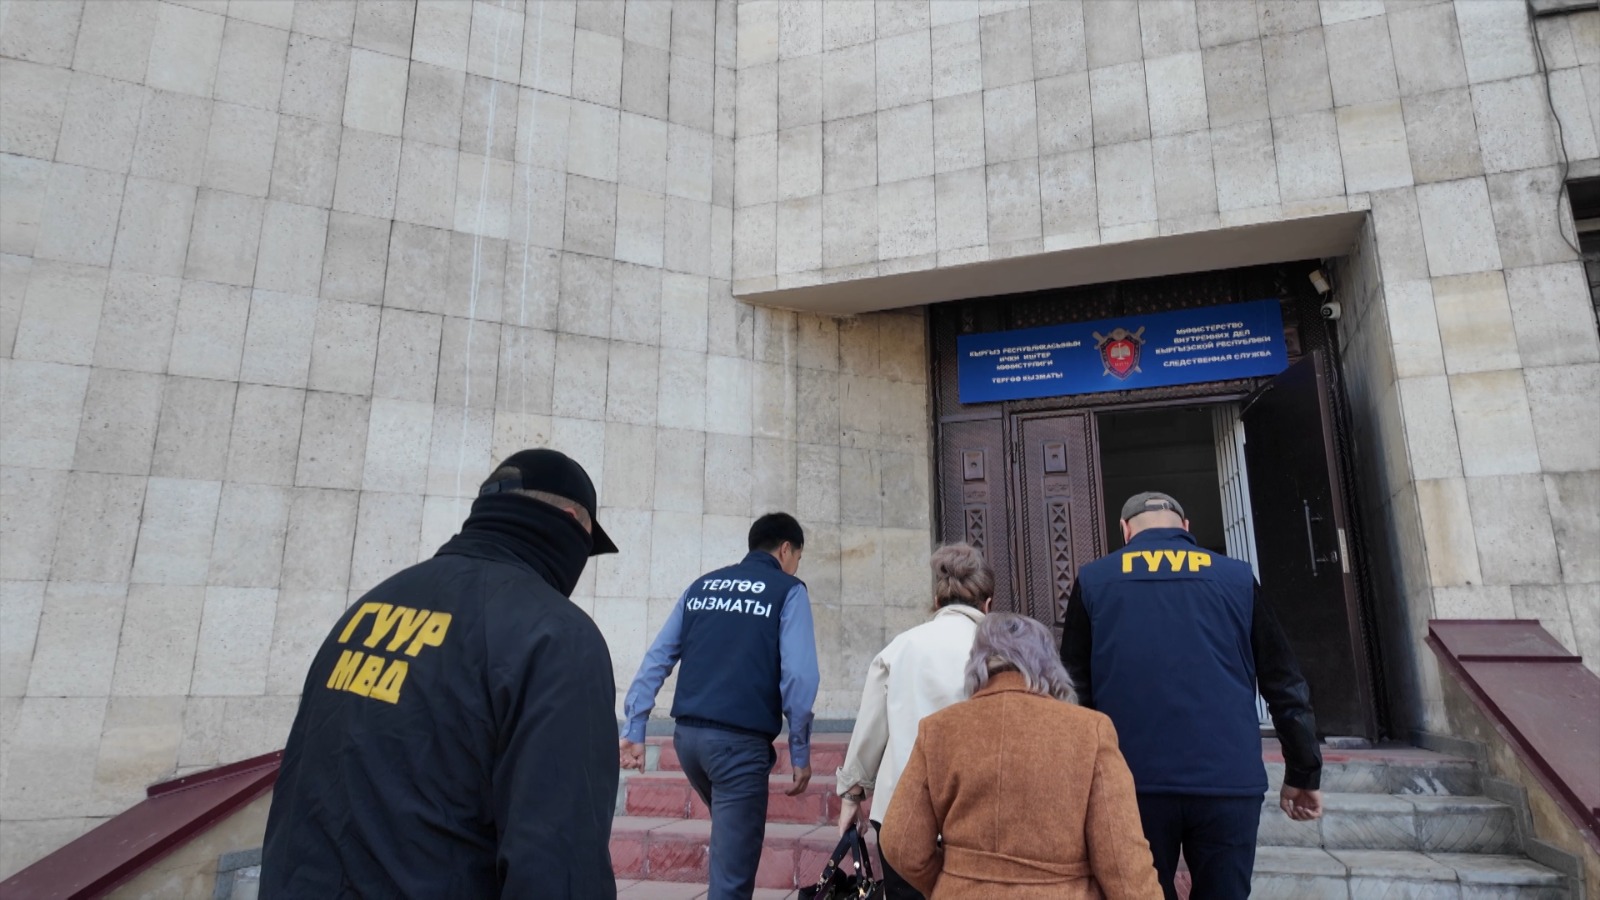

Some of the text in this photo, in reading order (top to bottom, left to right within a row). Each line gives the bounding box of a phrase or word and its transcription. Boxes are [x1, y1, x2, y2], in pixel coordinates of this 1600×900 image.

[1176, 321, 1244, 335] МИНИСТЕРСТВО
[1173, 329, 1251, 344] ВНУТРЕННИХ ДЕЛ
[969, 349, 1001, 357] КЫРГЫЗ
[1155, 336, 1272, 355] КЫРГЫЗСКОЙ РЕСПУБЛИКИ
[1023, 352, 1051, 361] ИШТЕР
[1163, 350, 1272, 367] СЛЕДСТВЕННАЯ СЛУЖБА
[1022, 372, 1064, 382] КЫЗМАТЫ
[1122, 550, 1212, 573] ГУУР
[702, 579, 766, 593] ТЕРГӨӨ
[337, 601, 453, 658] ГУУР
[326, 649, 409, 705] МВД
